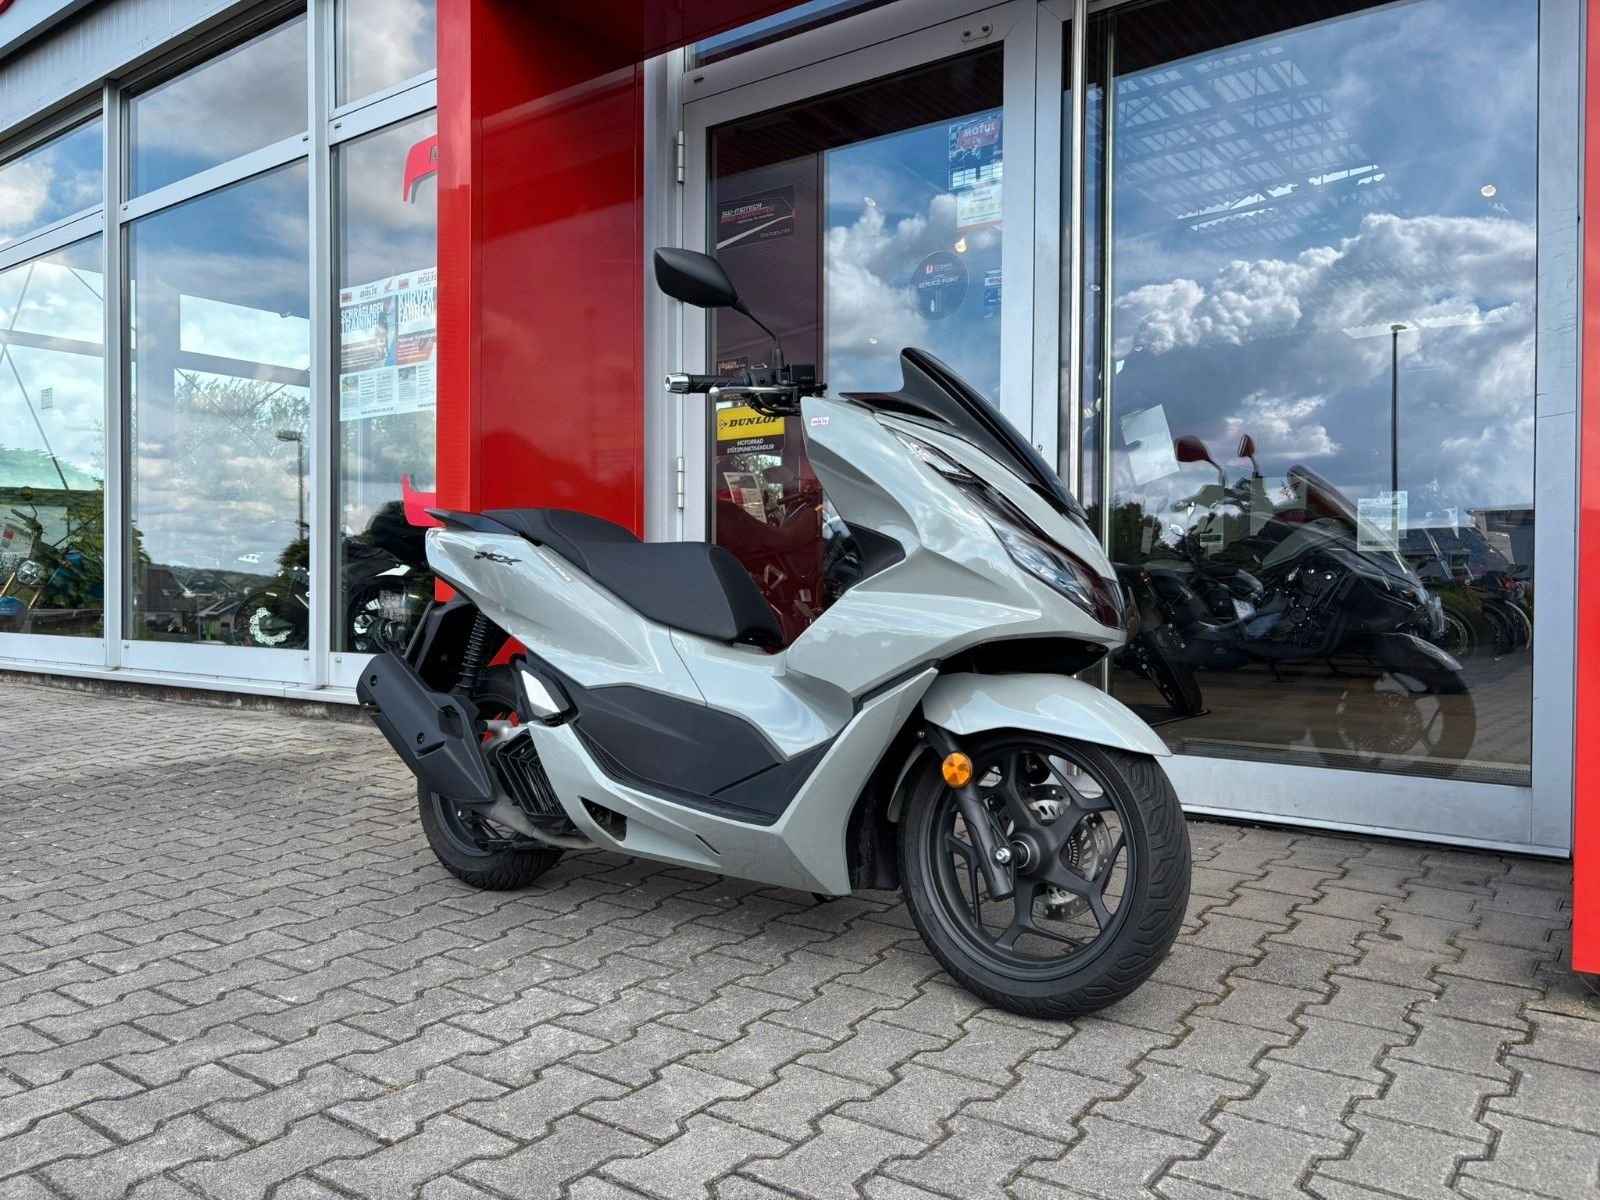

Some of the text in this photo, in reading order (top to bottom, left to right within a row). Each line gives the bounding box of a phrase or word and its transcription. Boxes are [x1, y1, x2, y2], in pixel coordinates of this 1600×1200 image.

[963, 122, 996, 137] MOTUL
[919, 279, 941, 289] SERVICE
[942, 275, 960, 284] POINT
[400, 286, 434, 307] KURVEN
[726, 443, 775, 454] STÜTZPUNKTHÄNDLER
[737, 438, 764, 447] MOTORRAD
